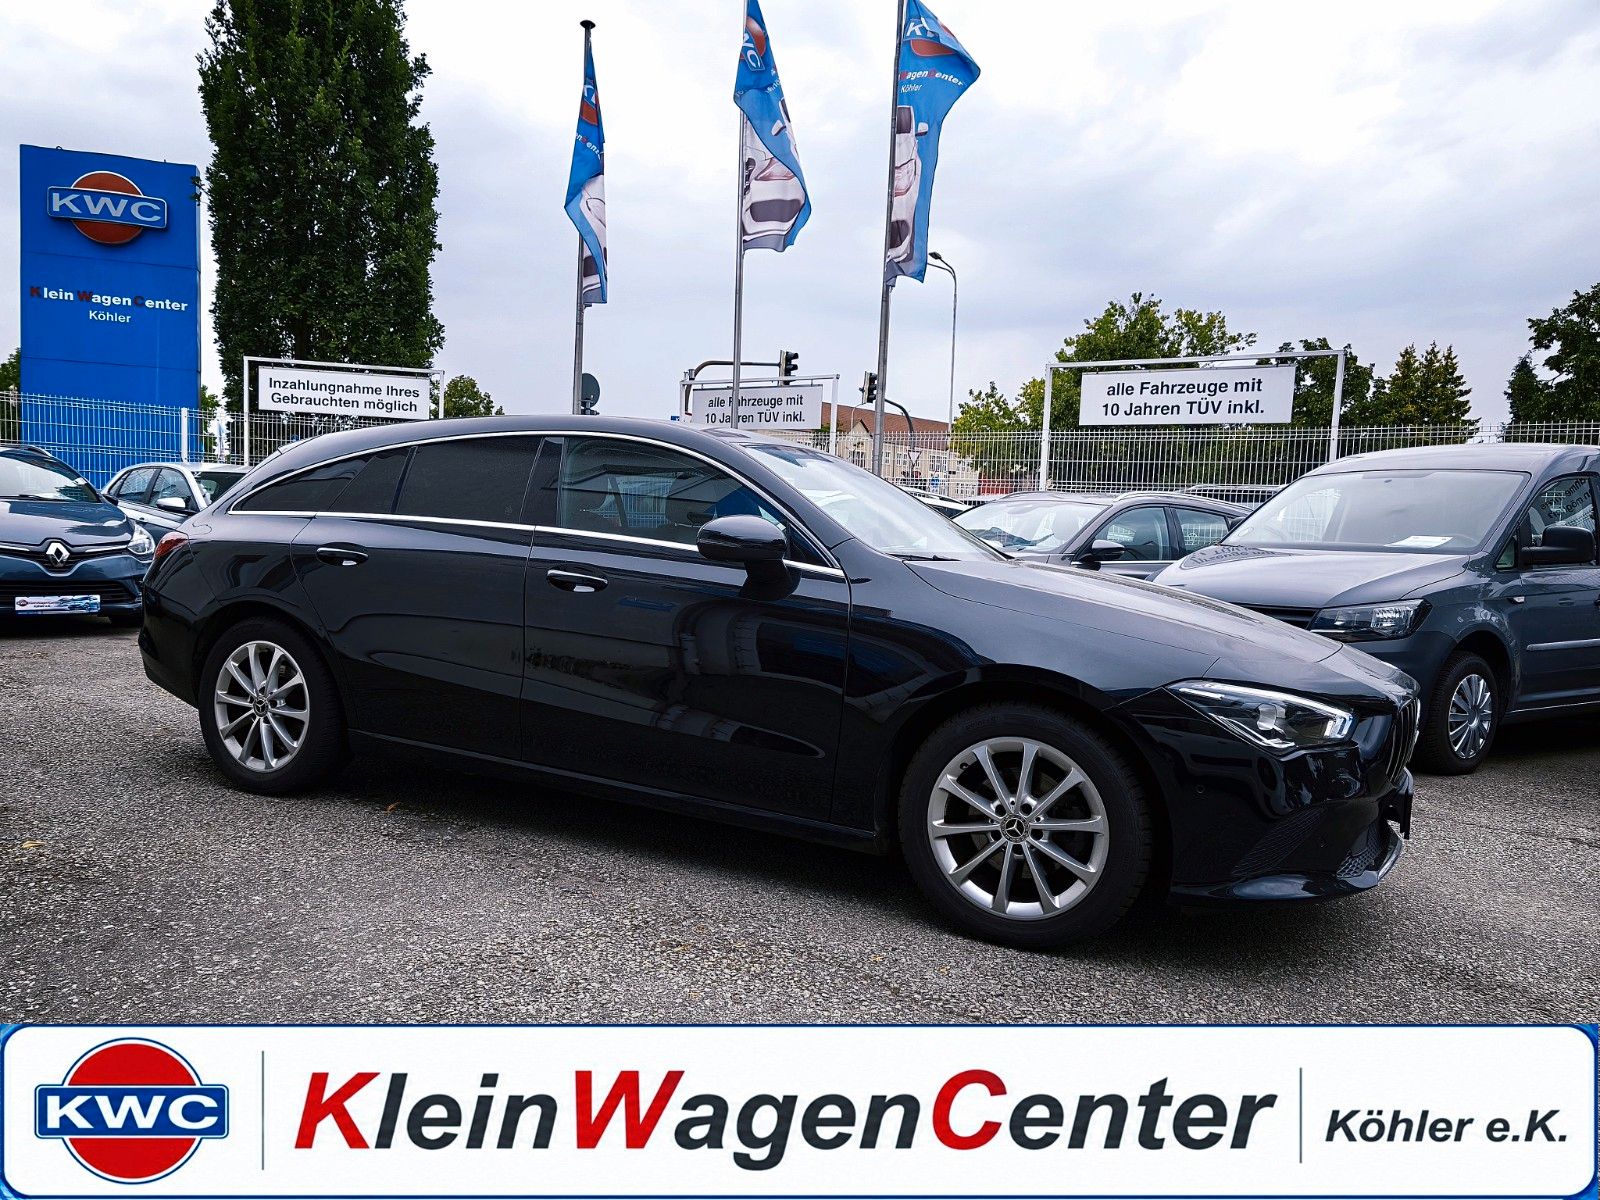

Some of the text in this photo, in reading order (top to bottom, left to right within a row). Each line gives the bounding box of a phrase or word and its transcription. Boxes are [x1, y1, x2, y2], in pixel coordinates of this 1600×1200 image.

[52, 192, 161, 222] KWC
[30, 286, 188, 311] Klein Wagen Center
[89, 310, 132, 323] Köhler
[269, 377, 420, 398] Inzahlungnahme Ihres
[1107, 378, 1263, 397] alle Fahrzeuge mit
[271, 392, 418, 413] Gebrauchten möglich
[708, 396, 726, 408] alle
[786, 394, 803, 406] mit
[1102, 397, 1265, 417] 10 Jahren TÜV inkl.
[705, 409, 806, 424] 10 Jaren TÜV inkl.
